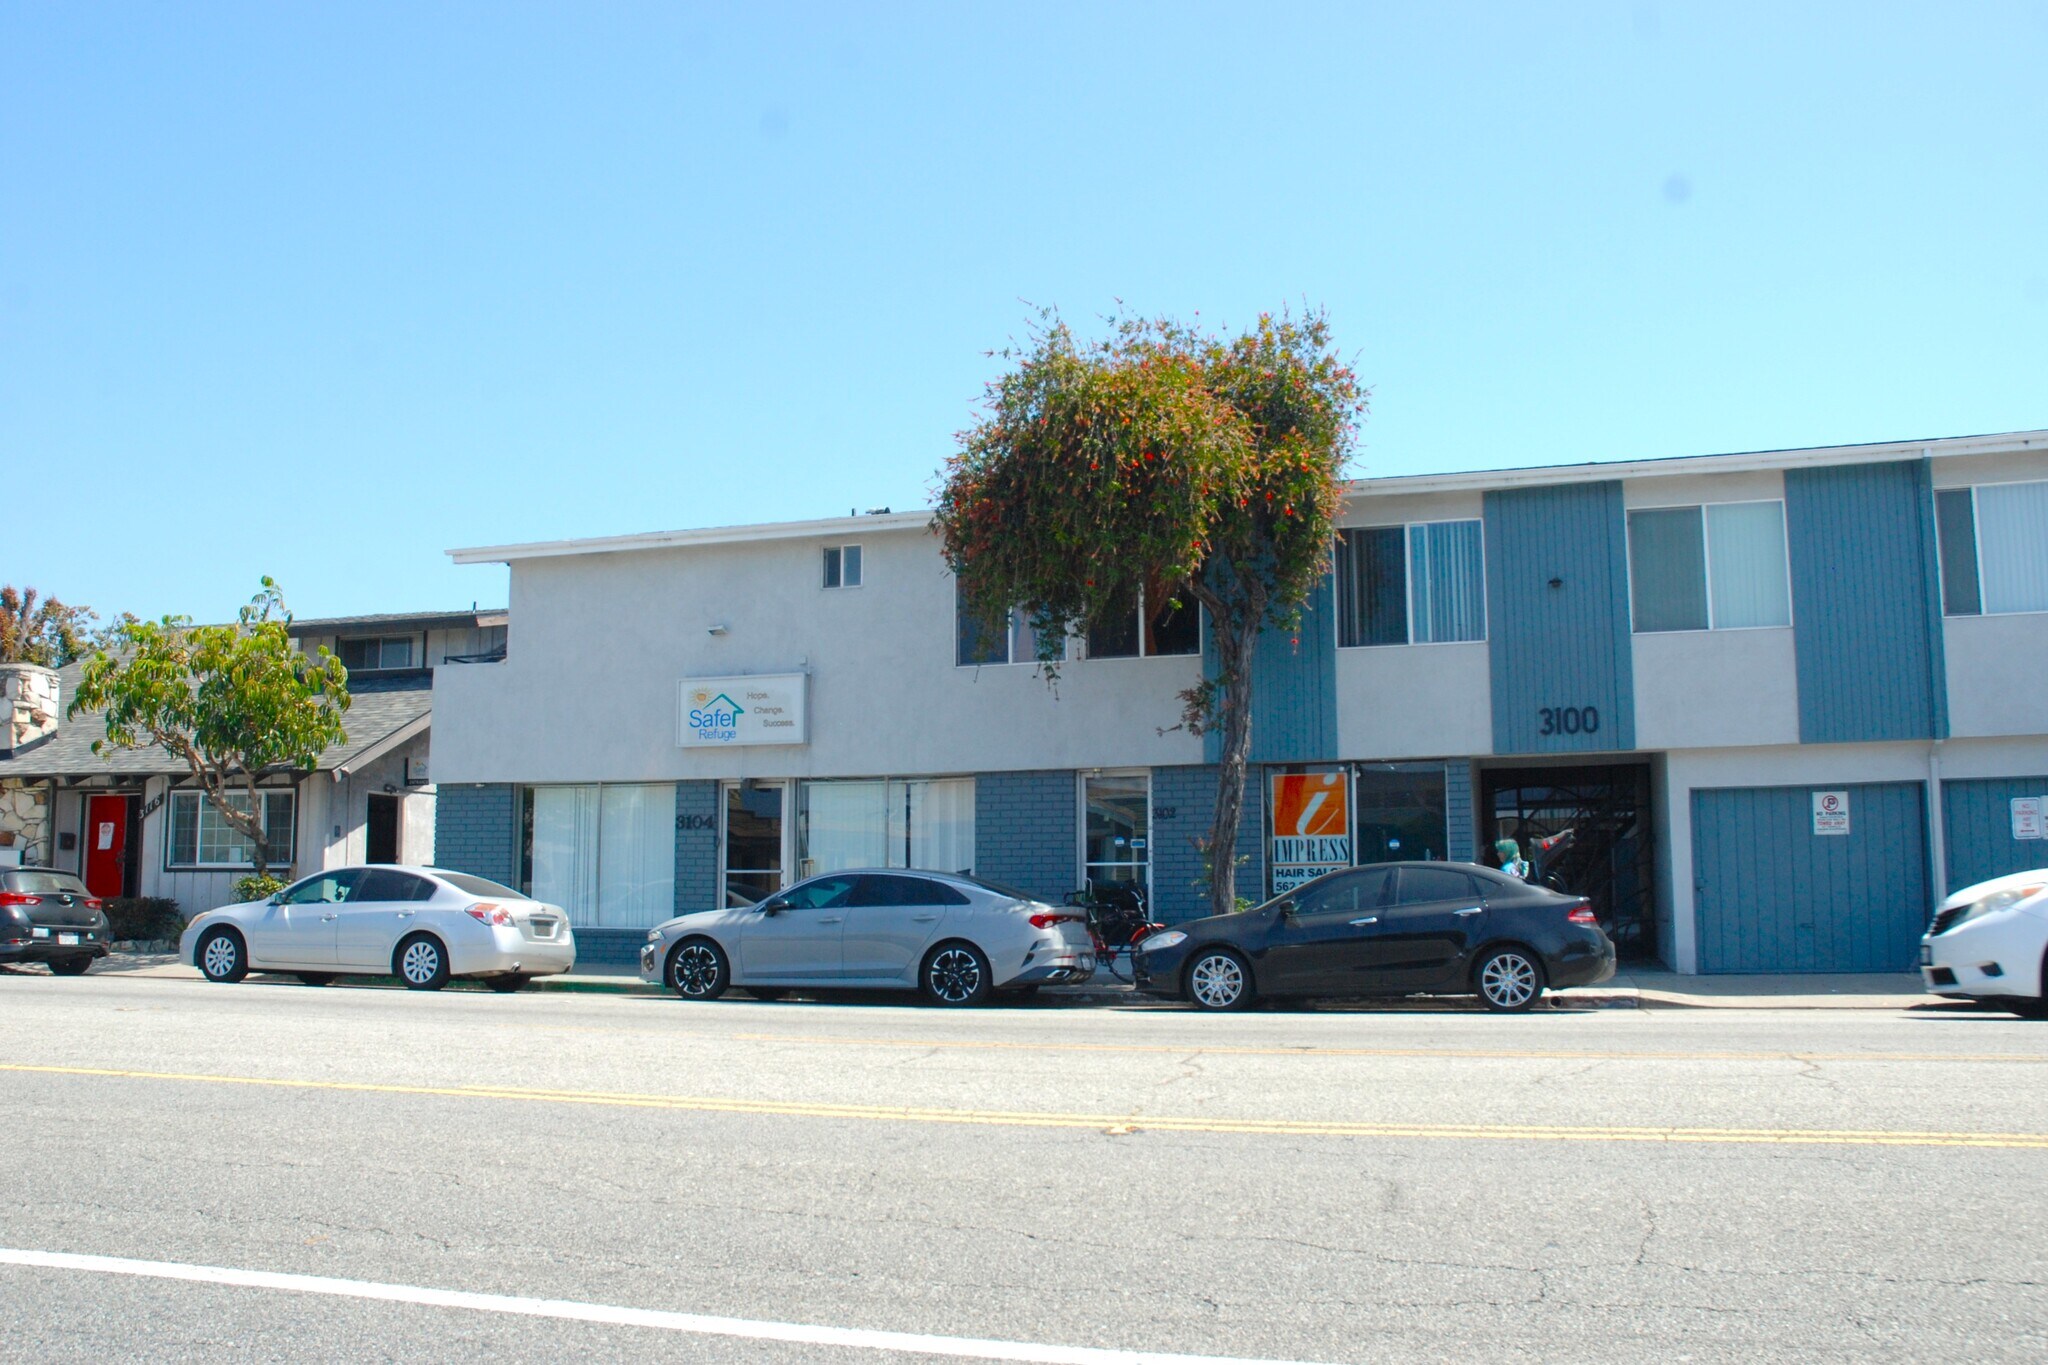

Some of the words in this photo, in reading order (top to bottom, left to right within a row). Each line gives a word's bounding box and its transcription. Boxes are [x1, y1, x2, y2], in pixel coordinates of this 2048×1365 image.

[689, 709, 736, 728] Safer
[763, 719, 795, 727] Success.
[1539, 706, 1599, 735] 3100
[699, 728, 736, 741] Refuge
[676, 815, 714, 829] 3104
[1274, 839, 1348, 862] IMPRESS
[1276, 868, 1305, 877] HAIR
